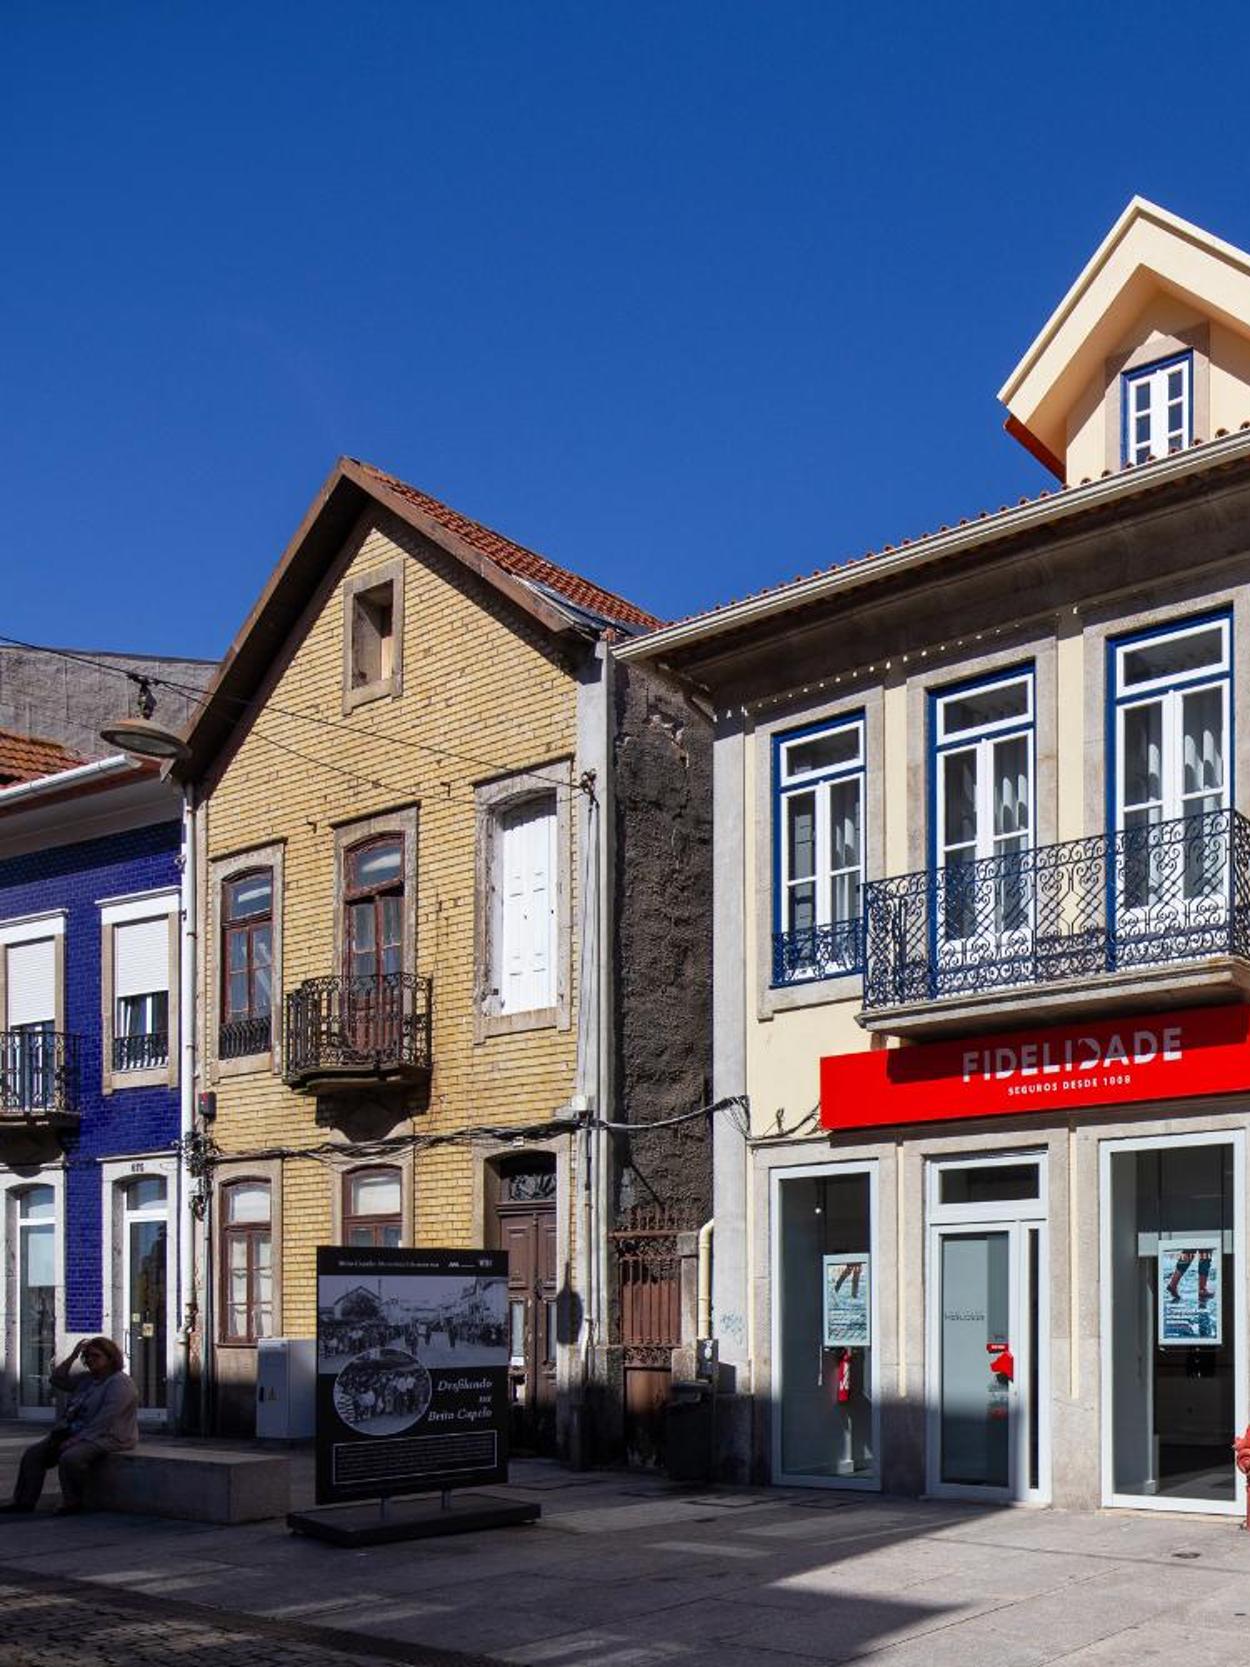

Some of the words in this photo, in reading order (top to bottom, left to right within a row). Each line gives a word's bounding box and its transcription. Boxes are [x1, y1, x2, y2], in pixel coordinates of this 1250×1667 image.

[962, 1027, 1183, 1083] FIDELIDADE
[1007, 1082, 1058, 1096] SEGUROS
[1063, 1077, 1098, 1091] DESDE
[1103, 1074, 1132, 1087] 1808
